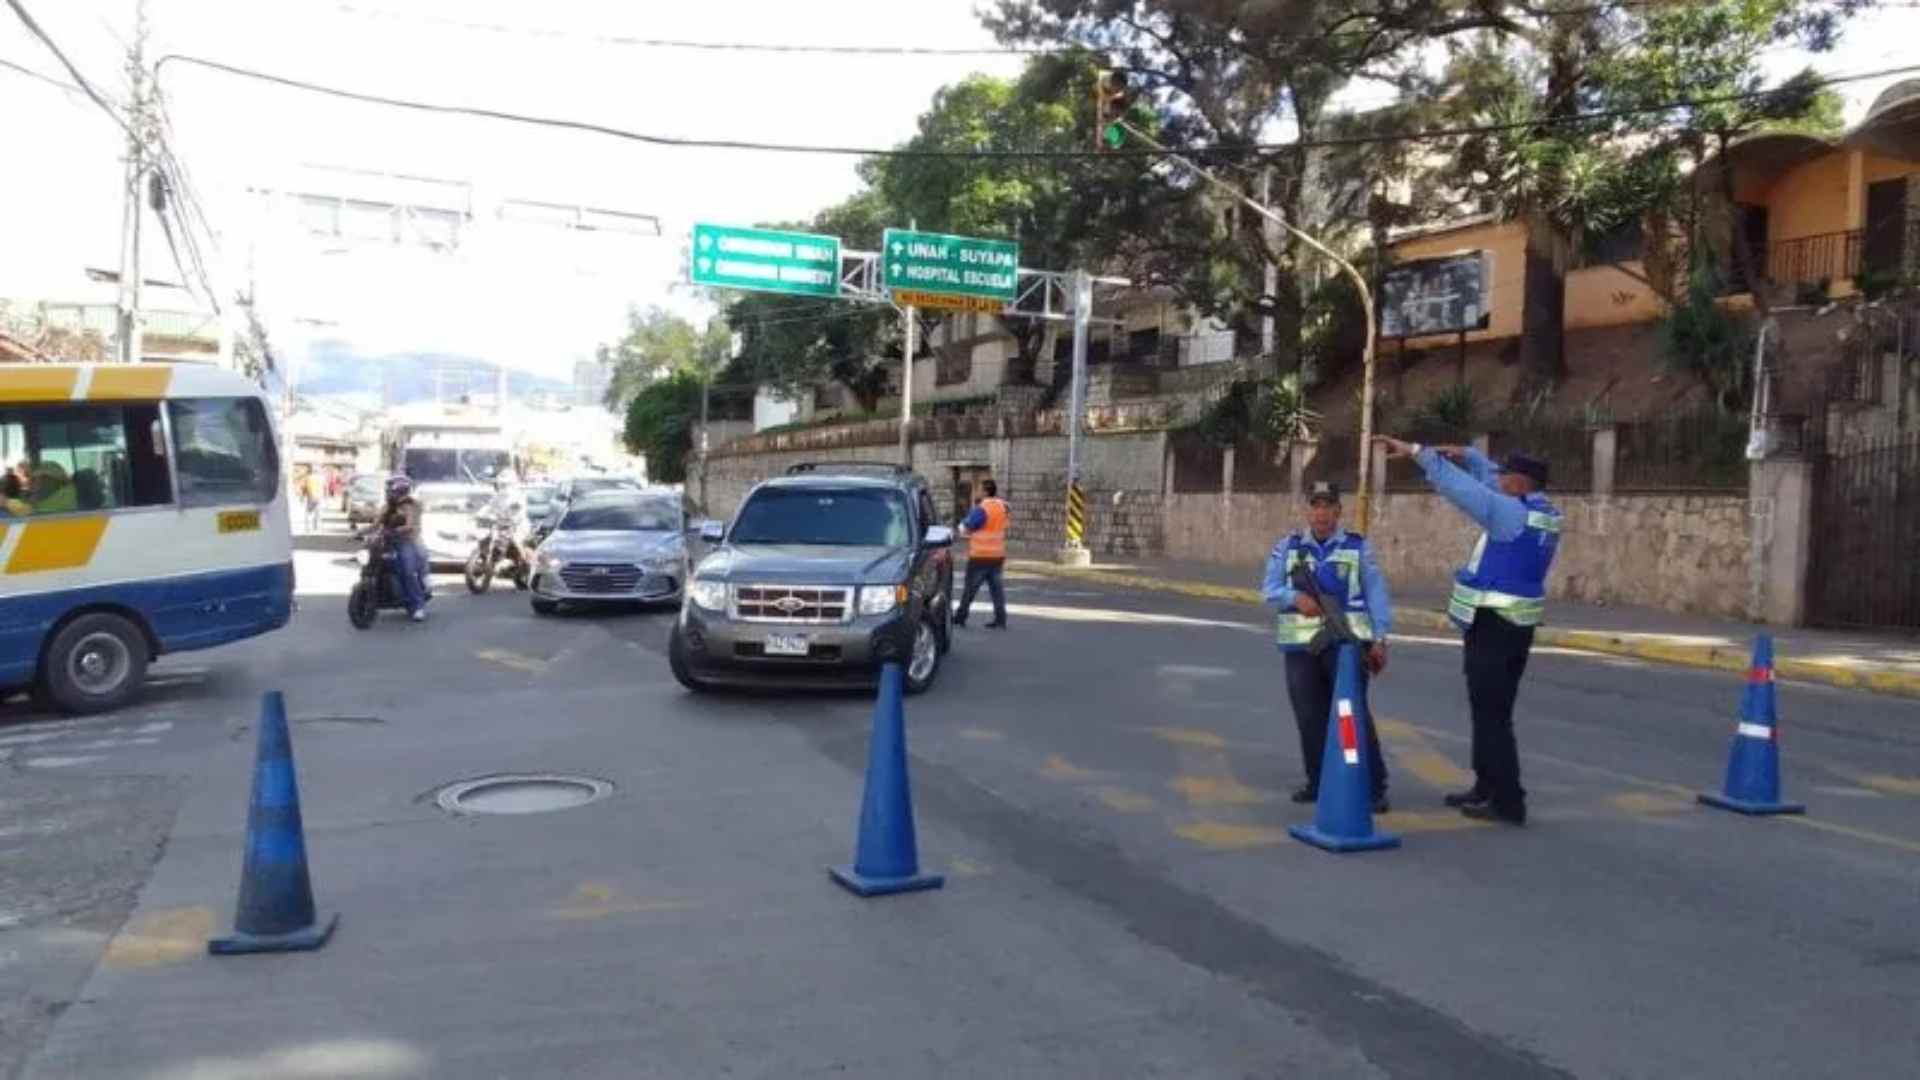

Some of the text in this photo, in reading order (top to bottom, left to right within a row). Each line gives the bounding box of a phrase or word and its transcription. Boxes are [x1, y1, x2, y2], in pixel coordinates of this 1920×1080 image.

[907, 242, 949, 260] UNAH
[960, 249, 1014, 267] SUYAPA
[906, 265, 1012, 289] HOSPITAL ESCUELA
